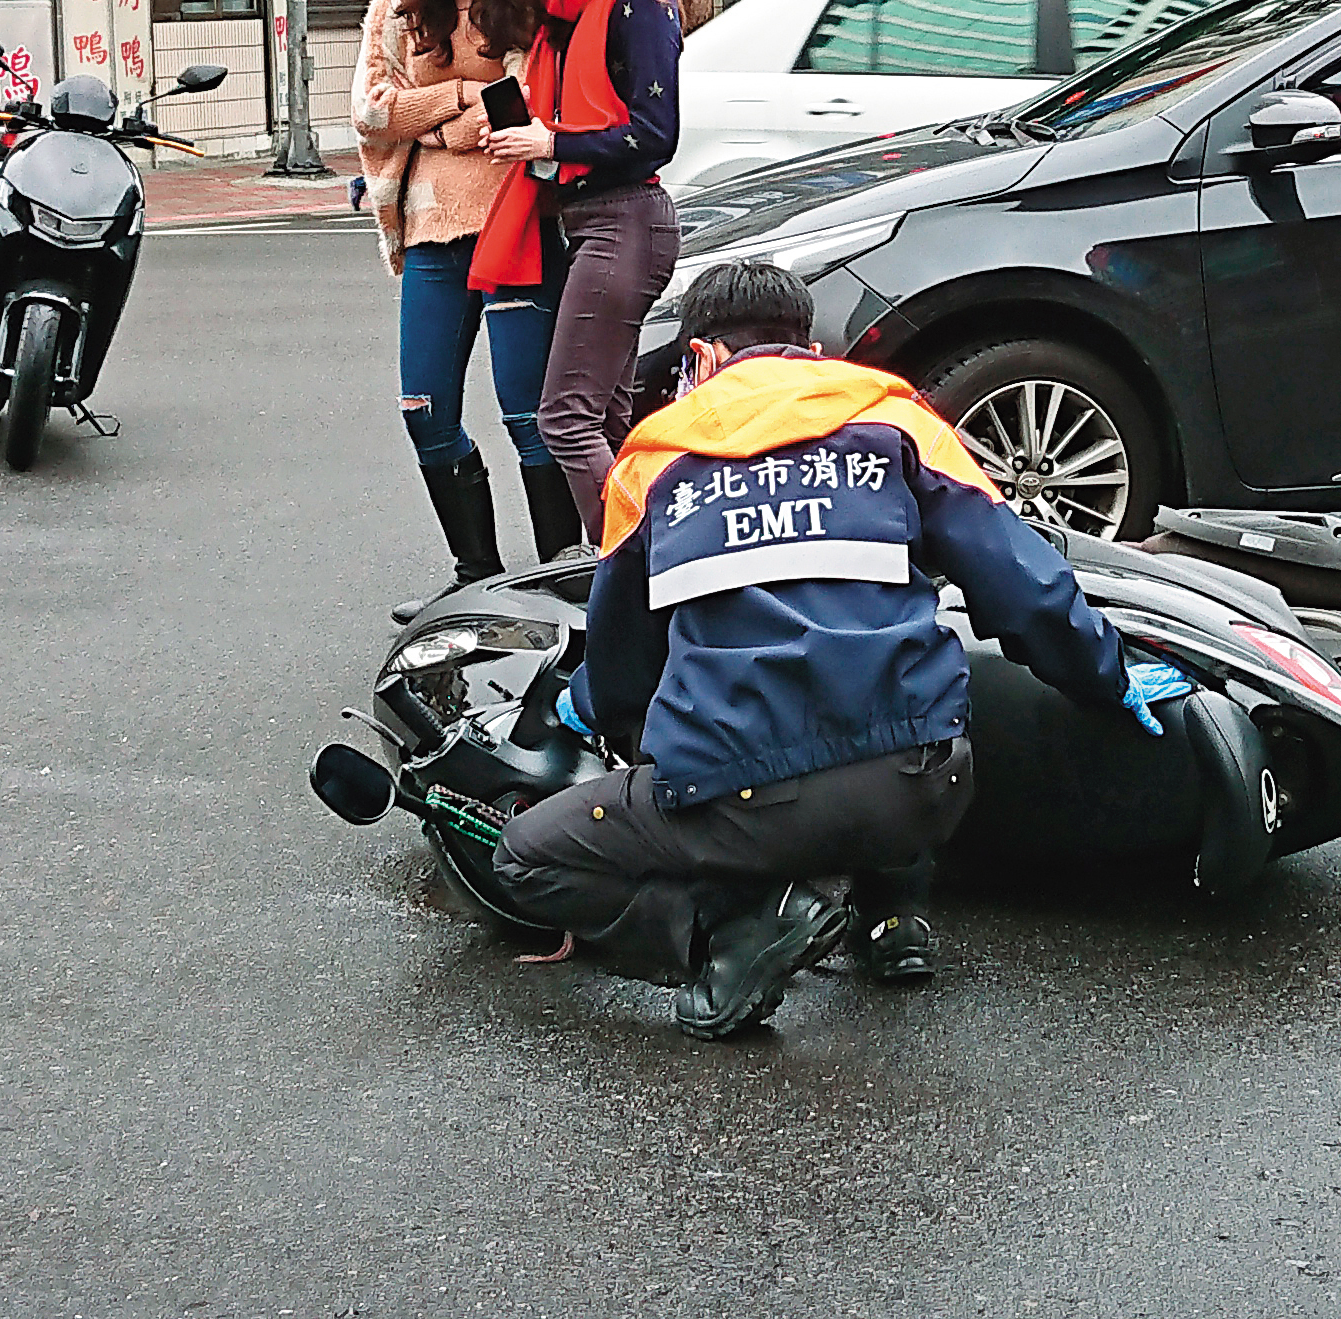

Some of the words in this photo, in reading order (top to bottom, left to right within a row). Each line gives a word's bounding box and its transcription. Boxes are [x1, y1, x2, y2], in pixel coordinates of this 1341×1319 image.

[666, 447, 890, 527] 臺北市消防
[722, 497, 832, 548] EMT
